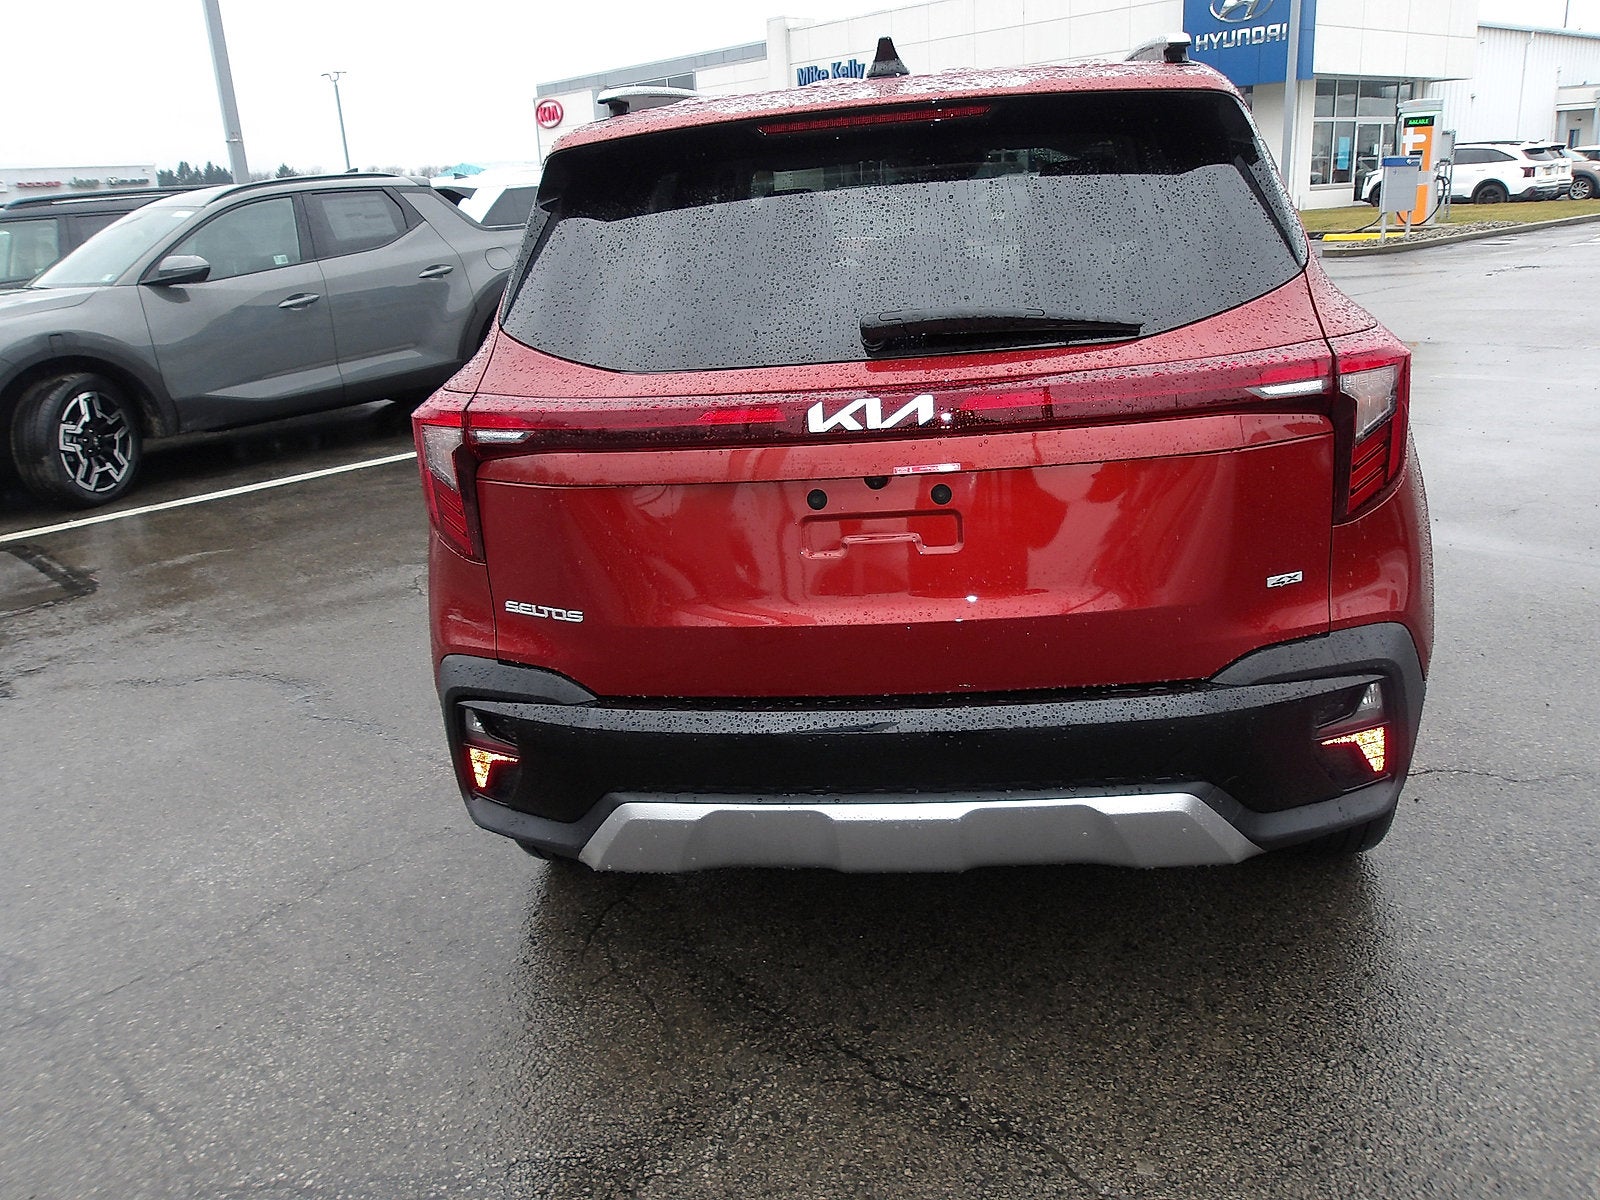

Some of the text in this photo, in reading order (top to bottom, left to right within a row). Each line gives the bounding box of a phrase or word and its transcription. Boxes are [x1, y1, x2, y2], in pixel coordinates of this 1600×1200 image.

[1195, 22, 1288, 52] HYUNDAI
[797, 59, 865, 86] Mike Kelly
[537, 104, 560, 123] KIA
[807, 394, 935, 433] KIA
[504, 600, 584, 623] SELTOS
